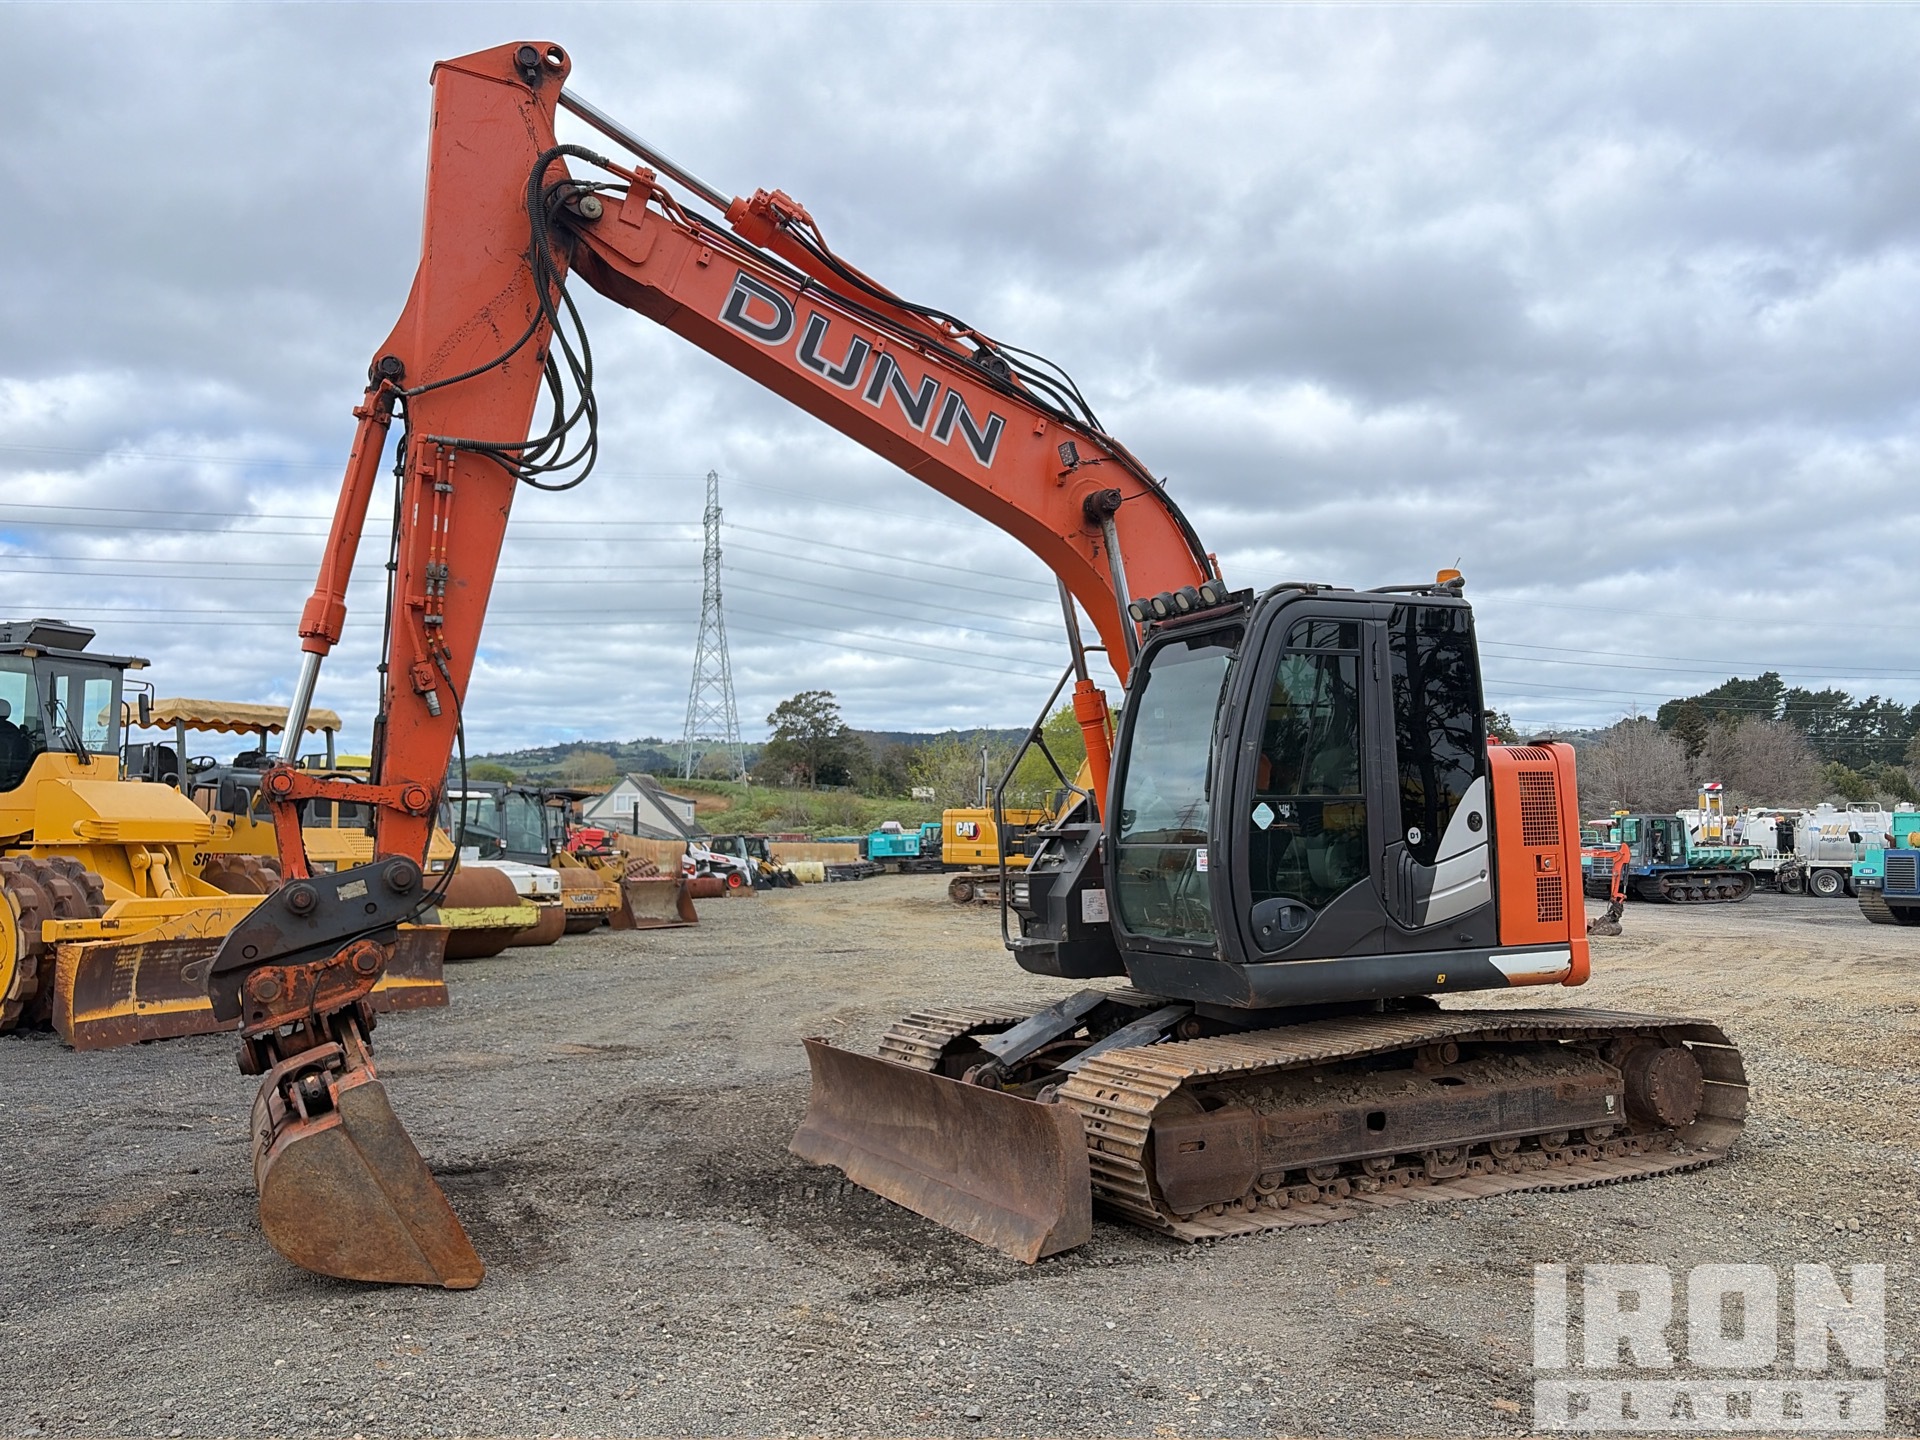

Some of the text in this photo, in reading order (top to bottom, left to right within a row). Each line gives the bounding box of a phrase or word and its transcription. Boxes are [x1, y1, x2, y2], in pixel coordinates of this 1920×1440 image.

[718, 269, 1006, 468] DUNN
[955, 821, 976, 837] CAT
[1820, 835, 1847, 843] Juggler
